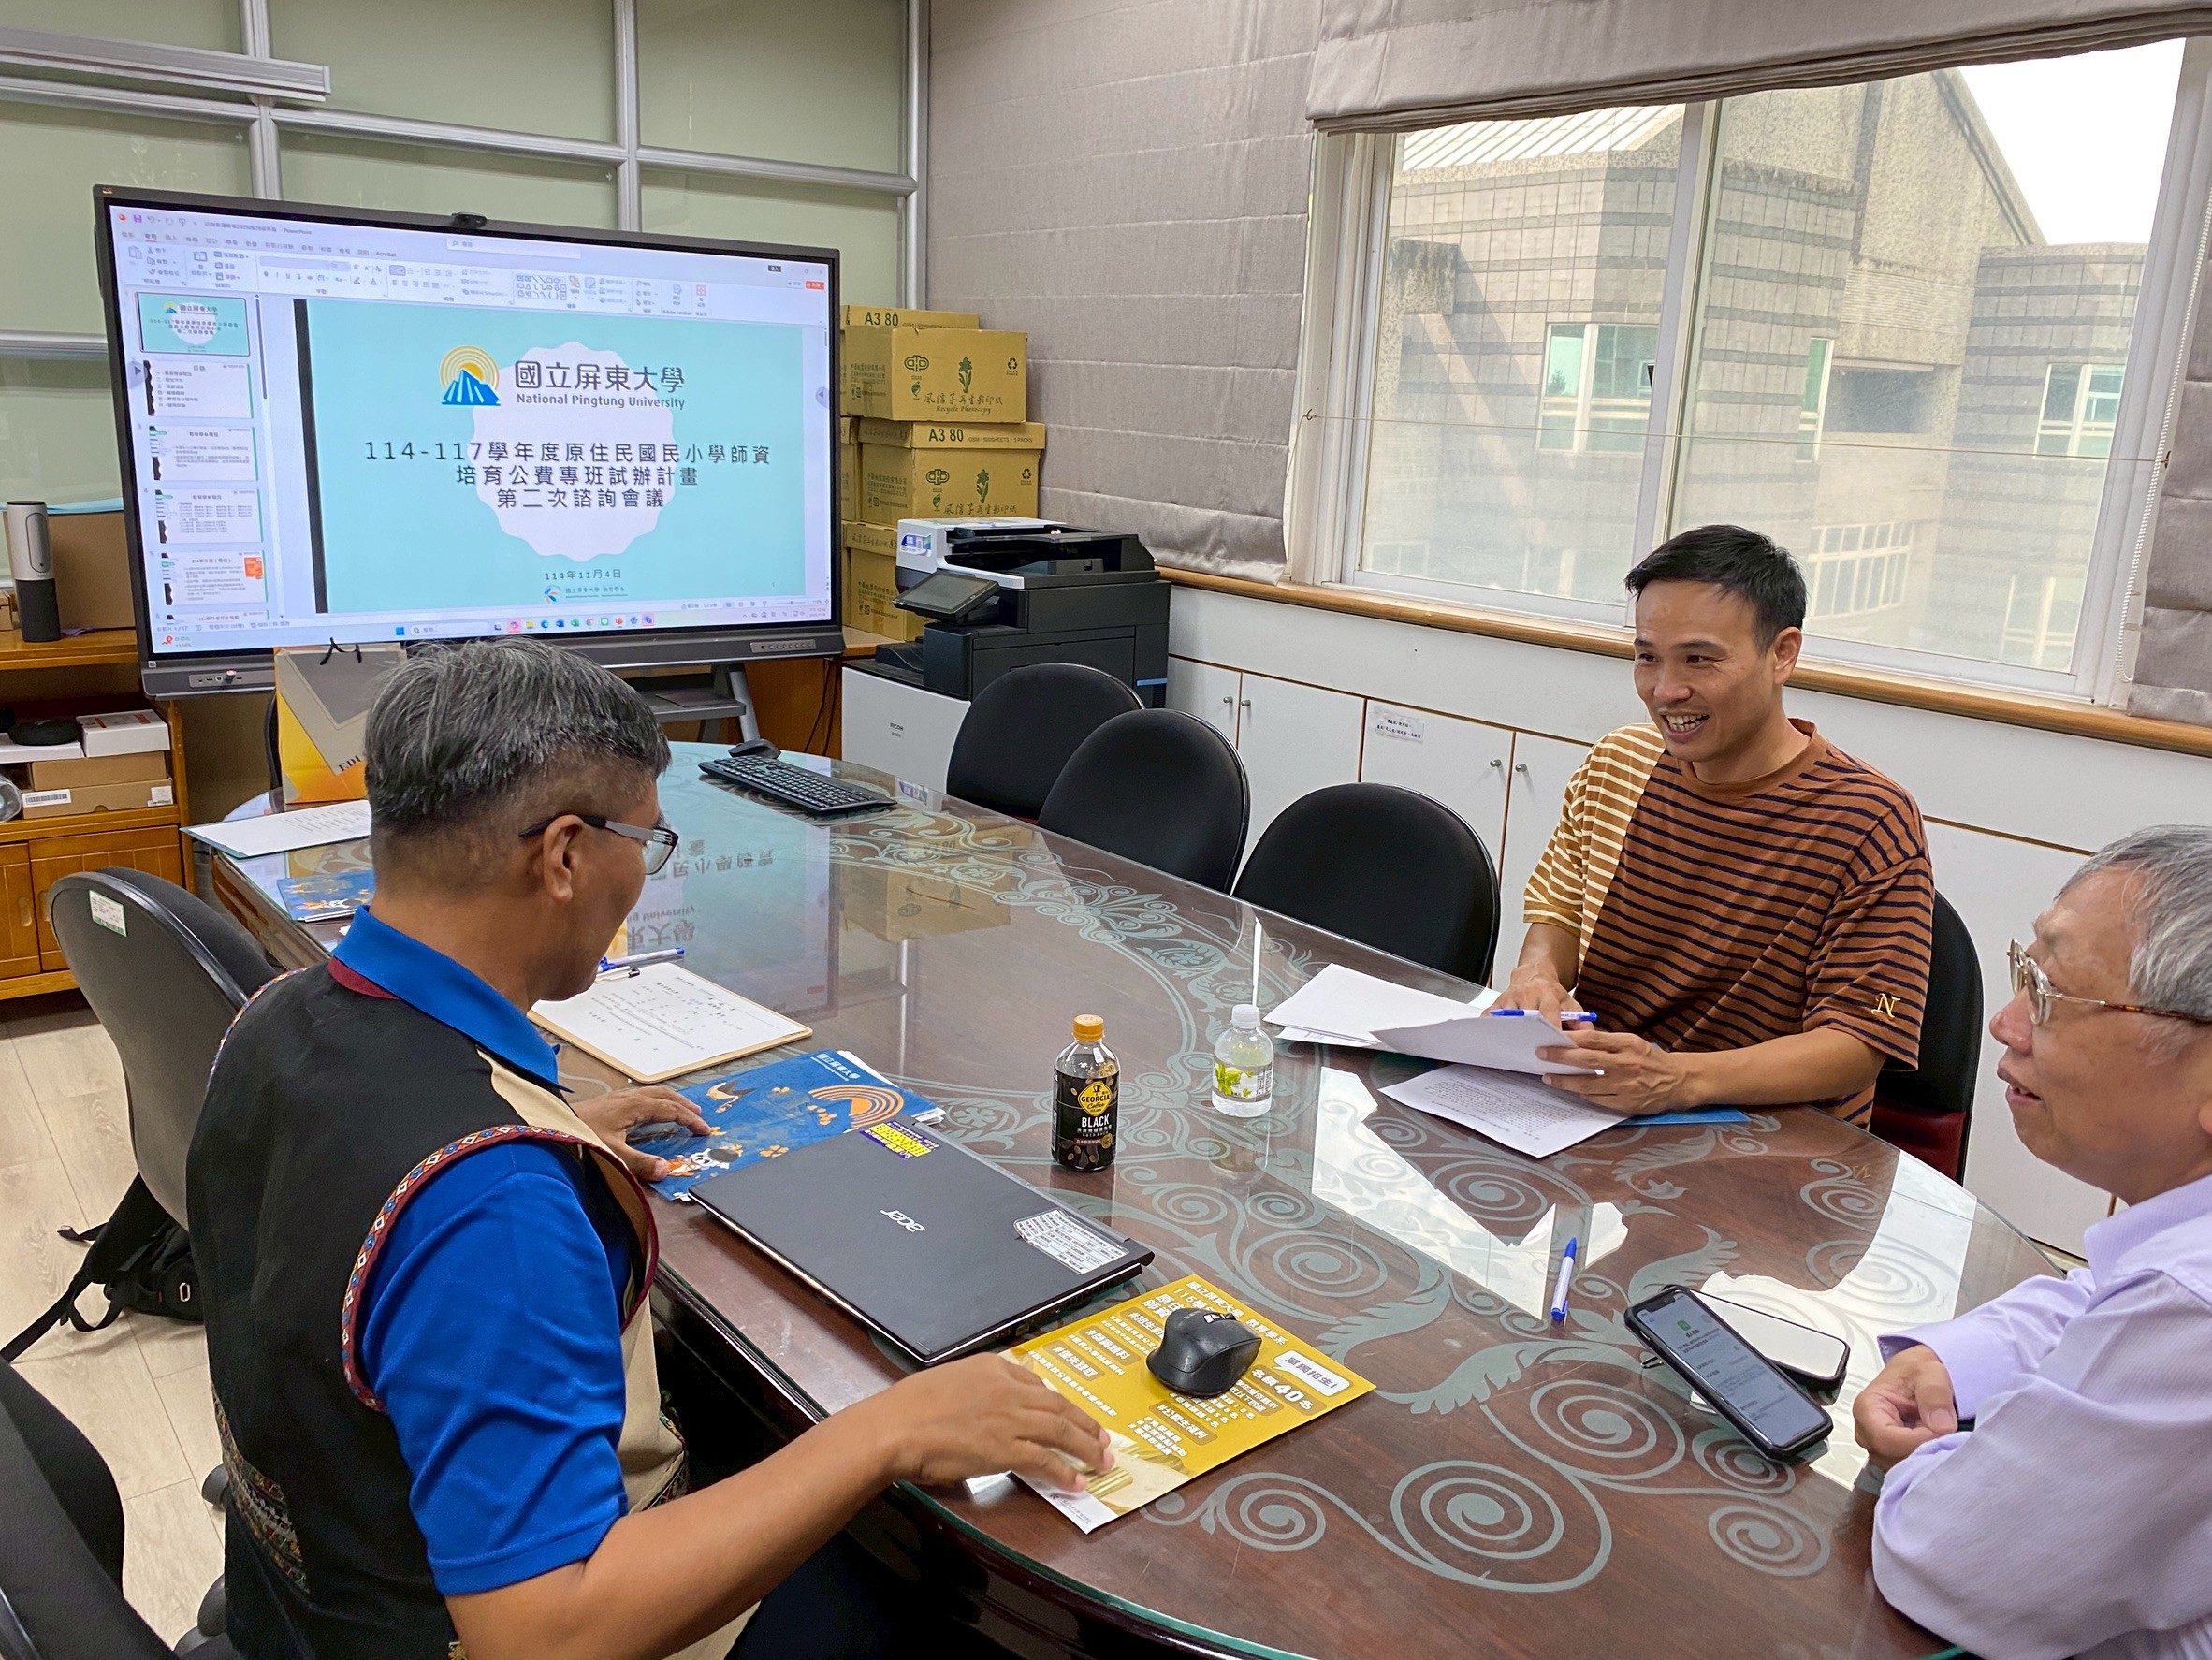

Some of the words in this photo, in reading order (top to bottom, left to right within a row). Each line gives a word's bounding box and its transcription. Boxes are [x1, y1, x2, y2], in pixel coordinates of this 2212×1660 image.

[865, 312, 880, 326] A3
[884, 313, 898, 327] 80
[515, 359, 685, 394] 國立屏東大學
[517, 392, 568, 406] National
[572, 394, 625, 409] Pingtung
[628, 395, 685, 411] University
[928, 428, 945, 442] A3
[950, 429, 964, 442] 80
[364, 441, 771, 465] 114-117學年度原住民國民小學師資
[456, 465, 700, 487] 培育公費專班試辦計畫
[496, 488, 665, 509] 第二次諮詢會議
[545, 569, 621, 580] 114年11月4日
[1081, 1094, 1111, 1103] GEORGIA
[1081, 1114, 1110, 1128] BLACK
[880, 1209, 925, 1233] acer
